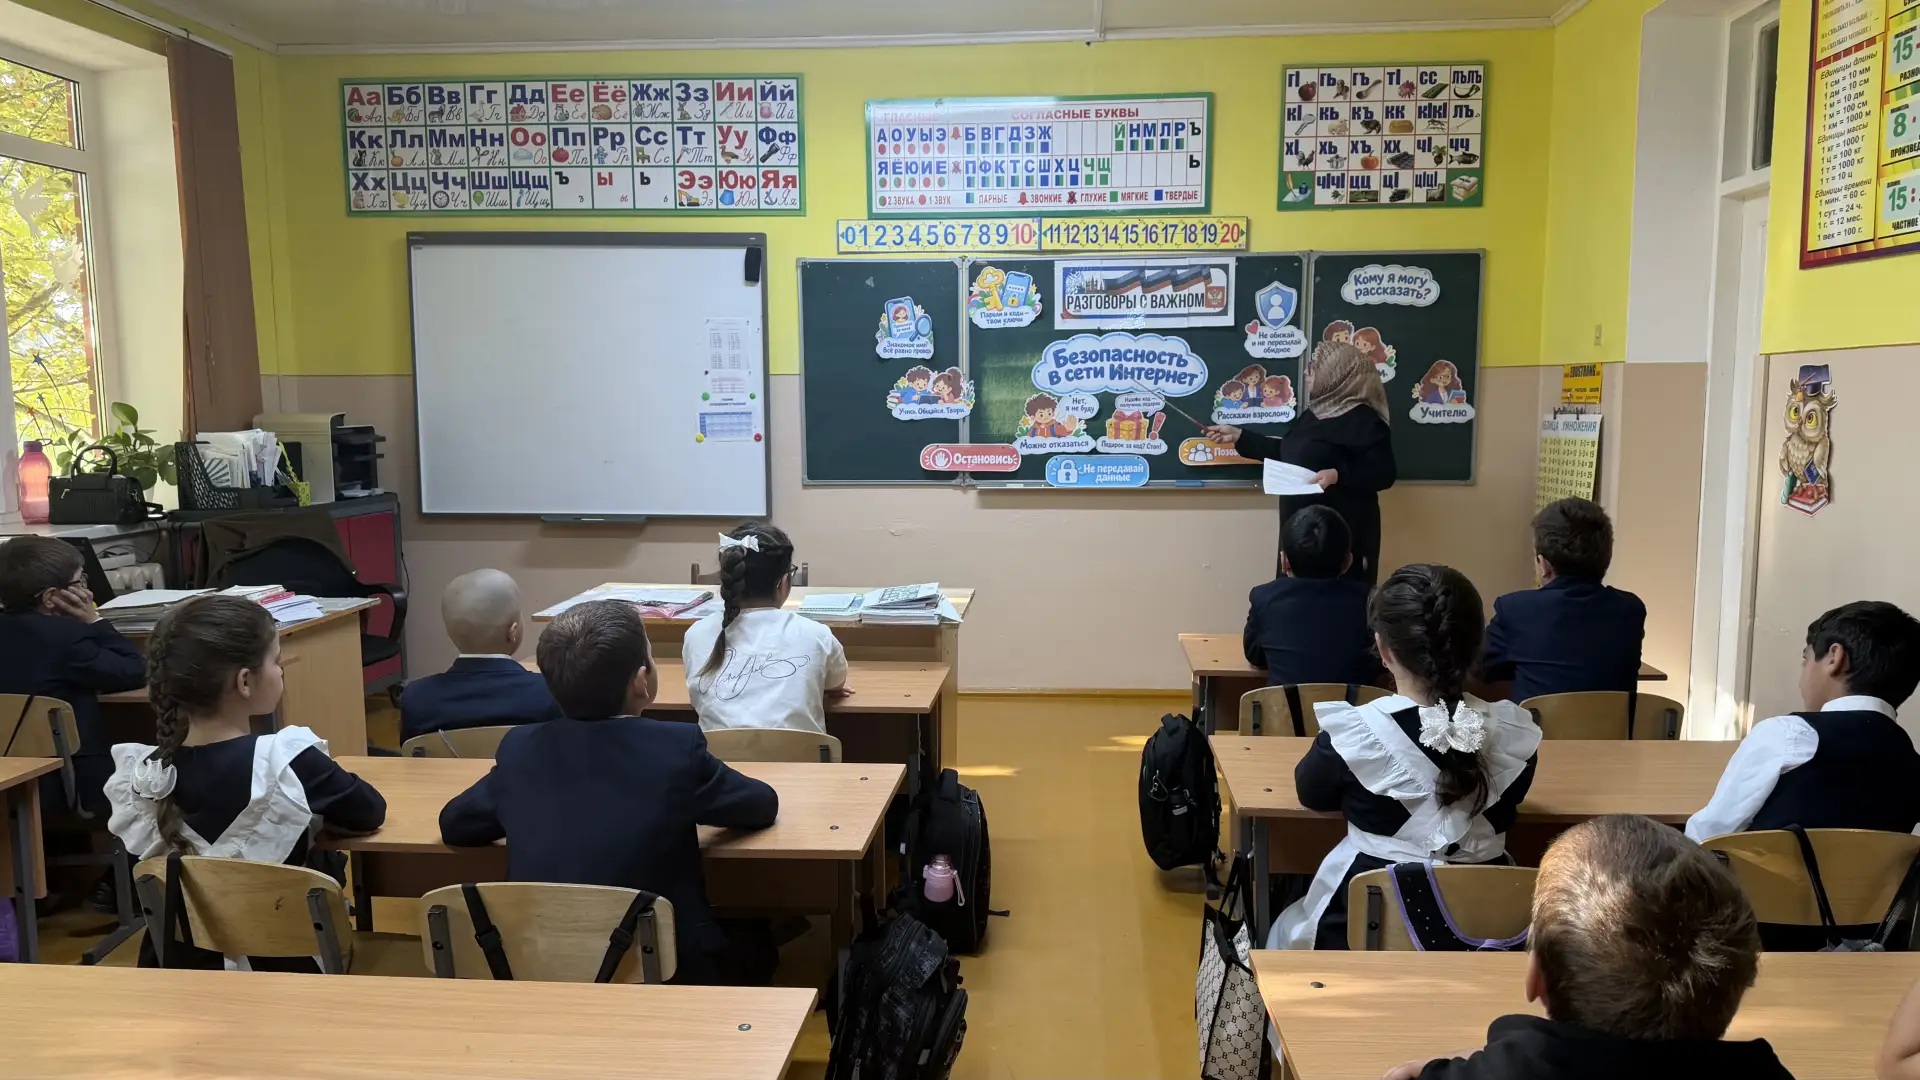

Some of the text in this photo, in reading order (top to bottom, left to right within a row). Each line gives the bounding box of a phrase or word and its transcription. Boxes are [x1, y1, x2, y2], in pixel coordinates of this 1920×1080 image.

[1893, 35, 1913, 64] 15
[1821, 51, 1877, 80] Единицы длины
[1849, 70, 1857, 79] 10
[1859, 66, 1870, 75] мм
[347, 87, 381, 105] Аа
[387, 86, 422, 105] Бб
[428, 86, 461, 104] Вв
[470, 86, 497, 104] Гг
[509, 85, 545, 105] Дд
[552, 84, 585, 103] Ее
[593, 82, 627, 102] Ёё
[632, 83, 670, 101] Жж
[675, 82, 709, 101] Зз
[716, 82, 753, 101] Ии
[760, 81, 794, 101] Йй
[1011, 108, 1139, 121] СОГЛАСНЫЕ БУКВЫ
[1846, 111, 1863, 124] 1000
[1818, 122, 1868, 144] Единицы массы
[1893, 112, 1907, 137] 8
[350, 130, 383, 149] Кк
[389, 129, 423, 148] Лл
[429, 129, 465, 148] Мм
[470, 128, 504, 147] Нн
[510, 127, 546, 147] Оо
[552, 127, 585, 147] Пп
[593, 127, 625, 150] Рр
[635, 126, 668, 146] Сс
[676, 126, 706, 145] Тт
[717, 125, 748, 149] Уу
[758, 126, 796, 145] Фф
[351, 172, 386, 191] Хх
[391, 172, 427, 194] Цц
[431, 171, 466, 190] Чч
[471, 171, 508, 190] Шш
[511, 170, 549, 190] Щщ
[678, 170, 713, 189] Ээ
[719, 170, 756, 189] Юю
[761, 170, 797, 189] Яя
[1815, 178, 1872, 198] Единицы времени
[893, 195, 915, 205] ЗВУКА
[934, 195, 951, 205] ЗВУК
[979, 194, 1008, 204] ПАРНЫЕ
[1031, 193, 1062, 203] ЗВОНКИЕ
[1080, 192, 1107, 202] ГЛУХИЕ
[1121, 191, 1149, 201] МЯГКИЕ
[1165, 190, 1198, 201] ТВЕРДЫЕ
[1889, 185, 1907, 212] 15
[1846, 204, 1854, 212] 24
[1049, 223, 1240, 243] 11 12 13 14 15 16 17 18 19 20
[1844, 227, 1856, 236] 100
[1892, 217, 1918, 231] ЧАСТНОЕ
[844, 223, 1033, 245] 0 1 2 3 4 5 6 7 8 9 10
[1354, 273, 1384, 286] Кому
[1398, 273, 1428, 289] могу
[1067, 295, 1136, 310] РАЗГОВОРЫ
[1151, 293, 1205, 309] ВАЖНОМ
[1354, 285, 1431, 300] рассказать?
[980, 311, 1002, 319] Пароли
[1009, 311, 1023, 319] коды
[1003, 317, 1023, 325] ключи
[1267, 339, 1302, 347] пересылай
[1270, 331, 1295, 339] обижай
[1053, 348, 1188, 368] Безопасность
[1065, 367, 1104, 382] сети
[1109, 364, 1199, 386] Интернет
[1080, 405, 1095, 413] буду
[1217, 410, 1290, 420] Расскажи взрослому
[1420, 407, 1467, 418] Учителю
[1020, 440, 1089, 449] Можно отказаться
[1101, 441, 1124, 449] Подарок
[953, 453, 1013, 466] Остановись
[1084, 463, 1144, 474] Не передавай
[1095, 473, 1131, 484] данные
